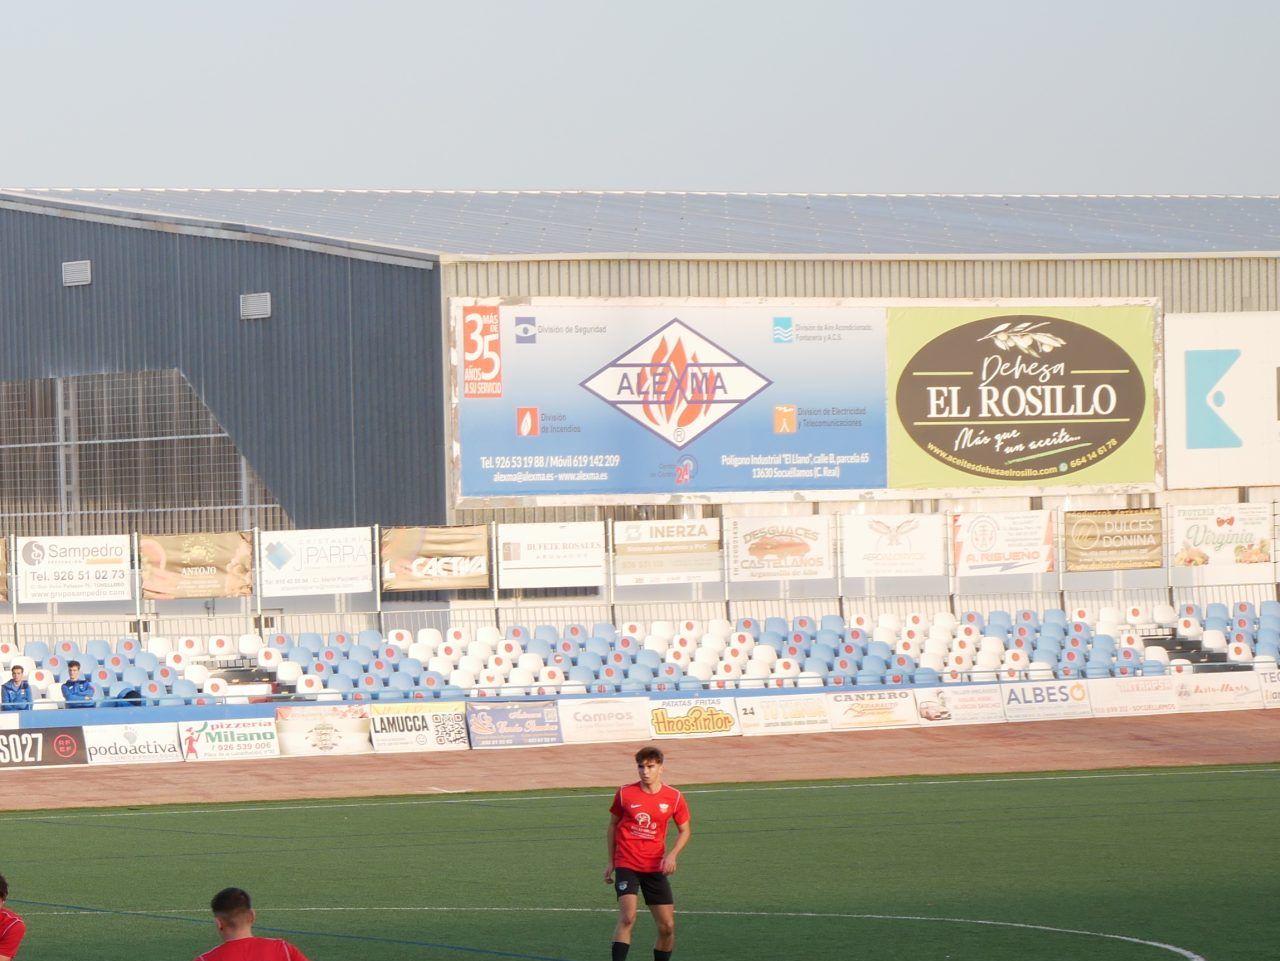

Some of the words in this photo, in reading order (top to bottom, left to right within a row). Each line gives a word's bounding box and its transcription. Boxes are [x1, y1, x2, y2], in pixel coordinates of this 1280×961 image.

[537, 325, 564, 334] División
[565, 325, 574, 334] de
[575, 325, 607, 335] Seguridad
[979, 354, 1065, 387] Dehesa
[926, 385, 971, 419] EL
[978, 383, 1118, 419] ROSILLO
[953, 426, 990, 452] Más
[993, 428, 1020, 453] que
[649, 524, 709, 539] INERZA
[1104, 519, 1155, 533] DULCES
[742, 526, 819, 545] DESGUACES
[1102, 533, 1157, 548] DONINA
[48, 543, 125, 560] Sampedro
[740, 556, 824, 570] CASTELLANOS
[29, 570, 51, 582] Tel.
[53, 570, 75, 582] 926
[77, 570, 91, 581] 51
[94, 569, 110, 581] 02
[111, 568, 127, 580] 73
[661, 700, 693, 708] PATATAS
[832, 691, 910, 703] CANTERO
[372, 714, 430, 735] LAMUCCA
[205, 730, 276, 744] Milano
[87, 740, 179, 762] podoactiva
